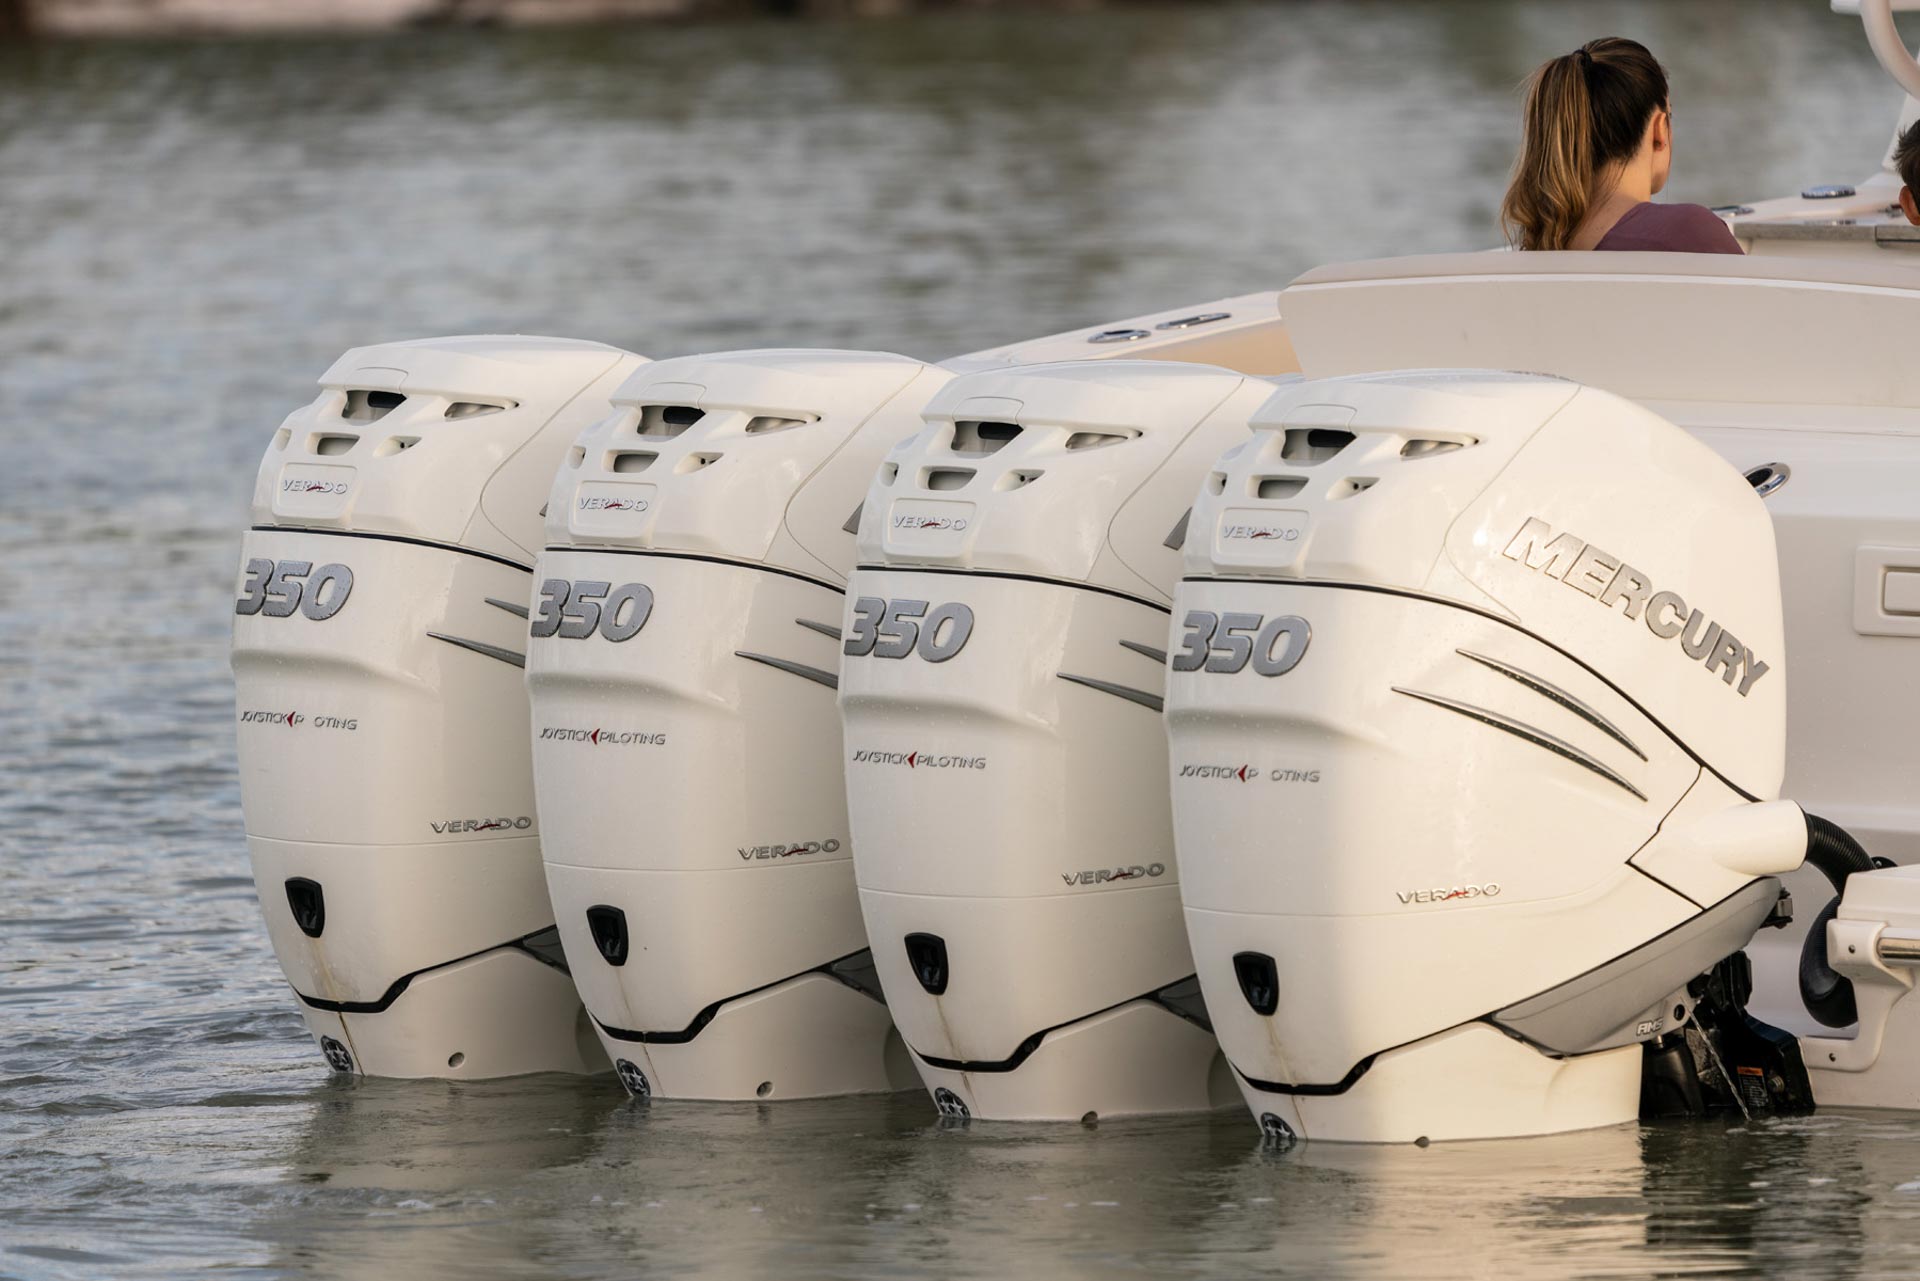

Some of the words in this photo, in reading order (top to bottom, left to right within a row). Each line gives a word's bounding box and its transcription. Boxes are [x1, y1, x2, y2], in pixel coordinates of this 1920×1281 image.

[283, 480, 348, 494] VERADO
[579, 497, 648, 512] VERADO
[894, 516, 967, 531] VERADO
[1223, 525, 1300, 541] VERADO
[235, 557, 354, 621] 350
[530, 578, 655, 644] 350
[1502, 516, 1770, 697] MERCURY
[843, 597, 975, 664] 350
[1172, 609, 1313, 677] 350
[240, 711, 288, 724] JOYSTICK
[540, 727, 592, 742] JOYSTICK
[599, 731, 666, 746] PILOTING
[853, 750, 908, 765] JOYSTICK
[916, 754, 987, 770] PILOTING
[1179, 764, 1239, 779] JOYSTICK
[430, 816, 532, 834] VERADO
[737, 838, 840, 860] VERADO
[1061, 863, 1165, 886] VERADO
[1396, 882, 1501, 904] VERADO
